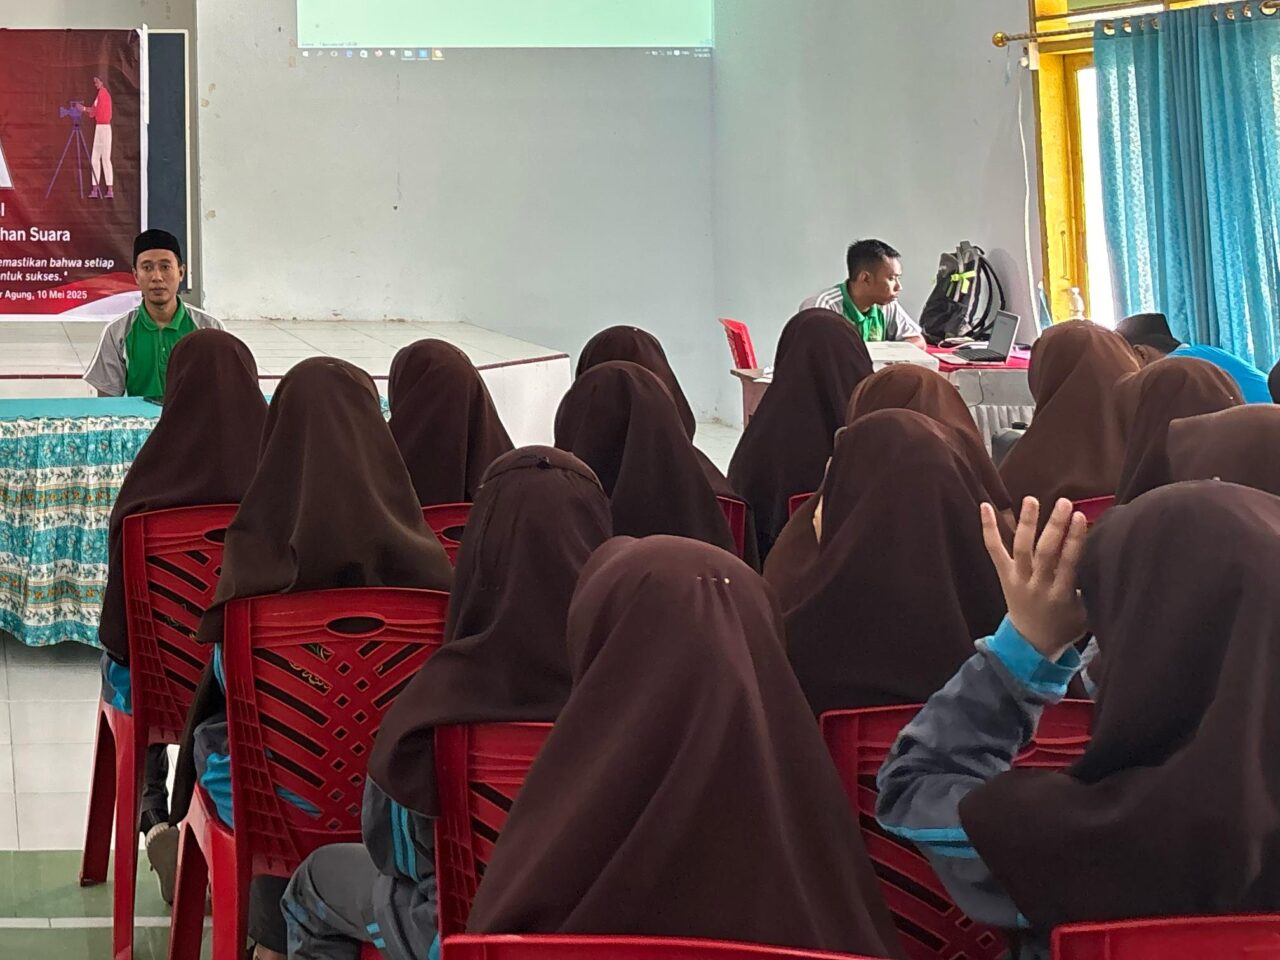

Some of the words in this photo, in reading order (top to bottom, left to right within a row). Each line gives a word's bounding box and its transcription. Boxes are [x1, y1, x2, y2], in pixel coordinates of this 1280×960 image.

[30, 227, 71, 241] Suara
[49, 257, 82, 268] bahwa
[84, 257, 115, 269] setiap
[5, 290, 35, 301] Agung,
[37, 290, 48, 299] 10
[51, 290, 65, 299] Mei
[67, 290, 88, 299] 2025
